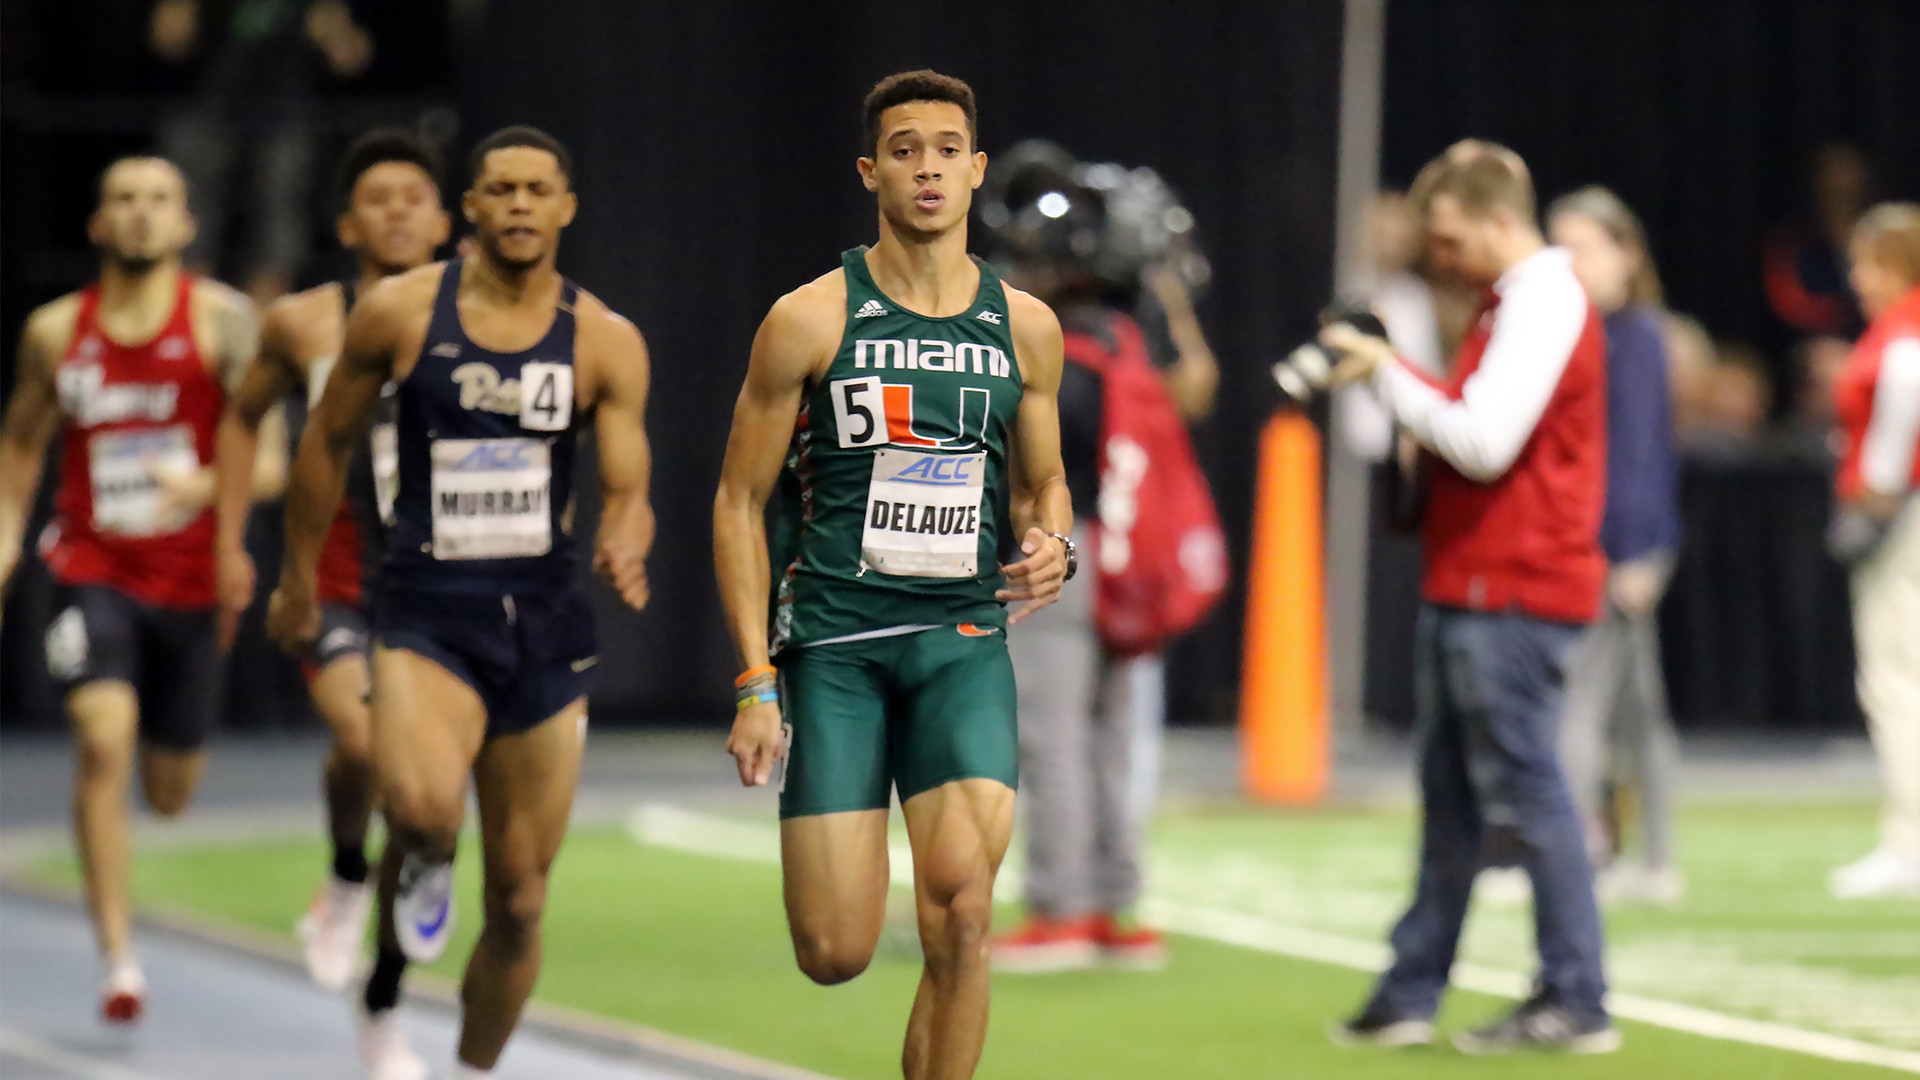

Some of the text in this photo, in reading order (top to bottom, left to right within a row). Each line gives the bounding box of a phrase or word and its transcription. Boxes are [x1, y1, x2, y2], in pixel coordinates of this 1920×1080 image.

[854, 309, 888, 319] adidas
[977, 310, 1003, 324] ACC
[532, 372, 558, 422] 4
[843, 382, 875, 444] 5
[897, 457, 974, 480] ACC
[869, 500, 977, 535] DELAUZE
